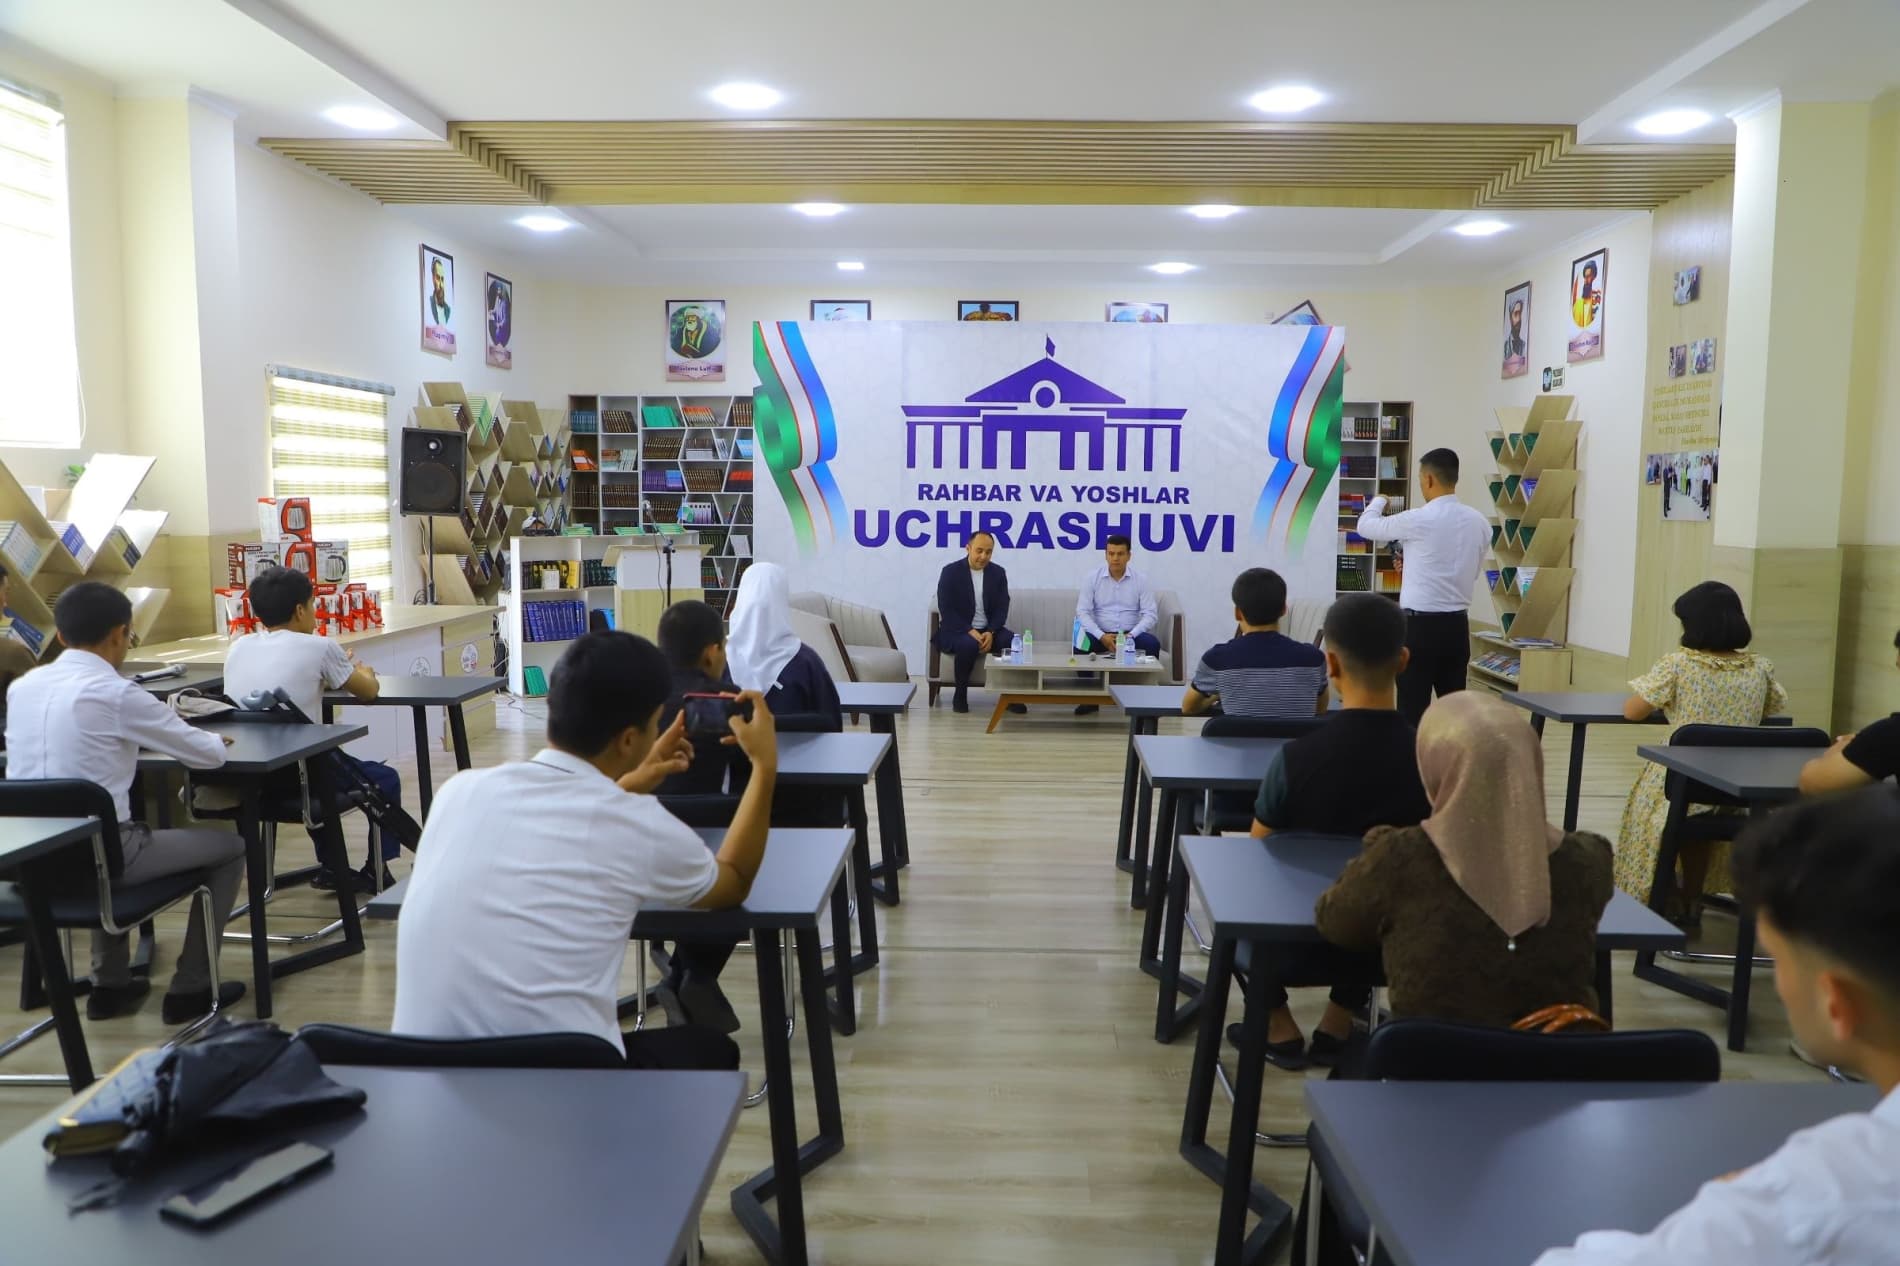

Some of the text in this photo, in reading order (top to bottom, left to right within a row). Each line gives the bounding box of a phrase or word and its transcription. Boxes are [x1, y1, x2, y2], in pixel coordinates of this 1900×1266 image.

[918, 483, 1190, 505] RAHBAR VA YOSHLAR
[853, 508, 1235, 553] UCHRASHUVI
